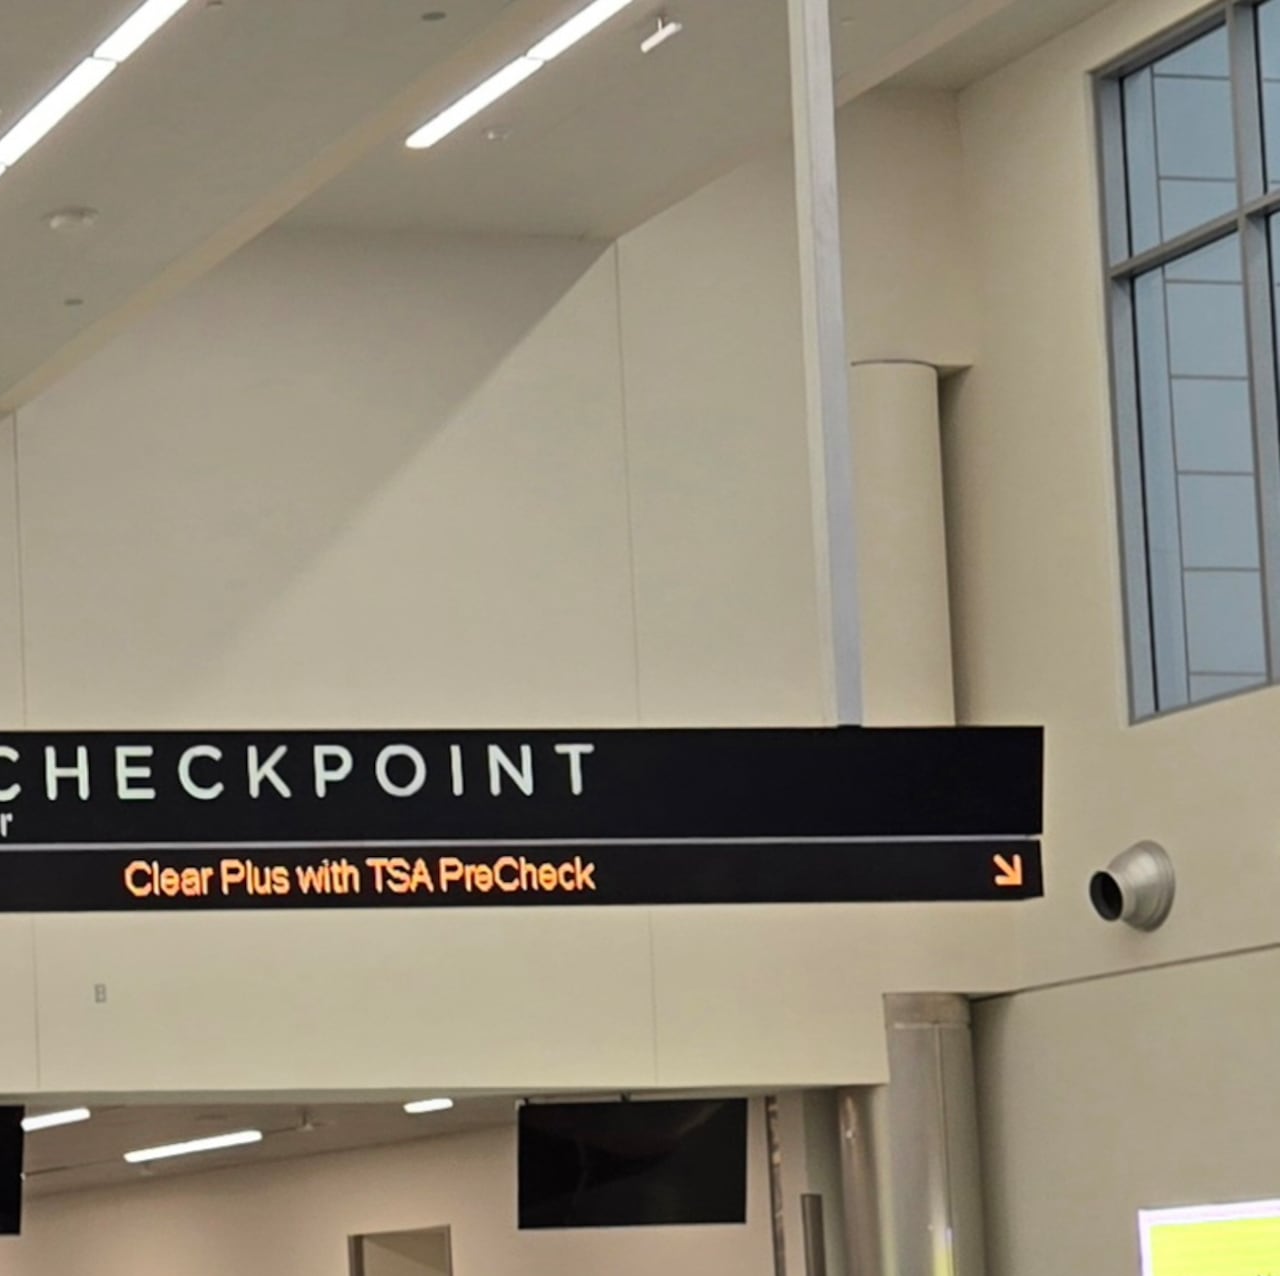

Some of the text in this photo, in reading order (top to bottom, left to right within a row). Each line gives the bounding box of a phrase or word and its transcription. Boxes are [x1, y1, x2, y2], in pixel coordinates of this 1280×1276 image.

[124, 855, 597, 897] Clear Plus with TSA PreCheck
